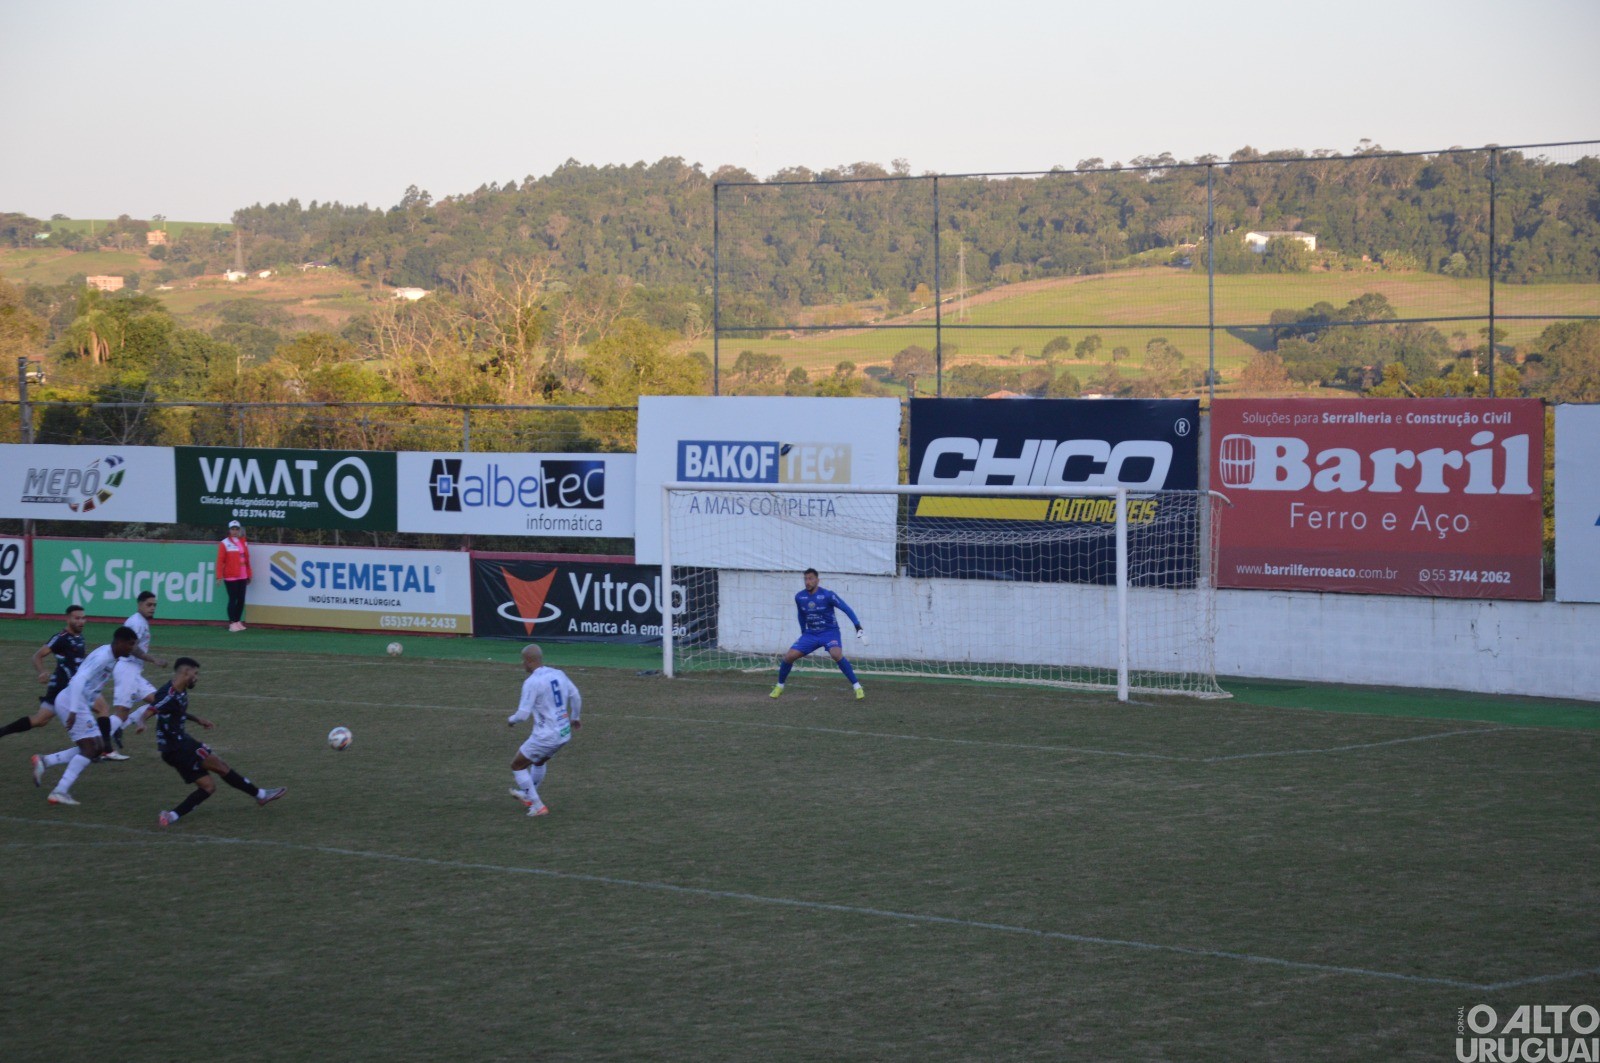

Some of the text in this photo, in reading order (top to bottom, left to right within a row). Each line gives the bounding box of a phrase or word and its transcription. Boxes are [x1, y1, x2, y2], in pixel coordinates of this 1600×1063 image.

[1242, 411, 1512, 427] Soluções para Serralheria e Construção Civil
[23, 459, 100, 496] MEPÓ
[199, 457, 318, 496] VMAT
[685, 445, 775, 479] BAKOF
[918, 437, 1173, 498] CHICO
[1249, 430, 1533, 494] Barril
[200, 496, 318, 509] Clínica de diagnóstico por imagem
[463, 463, 605, 509] albetec
[249, 510, 267, 518] 3744
[268, 510, 286, 518] 1622
[526, 514, 602, 531] informática
[689, 496, 836, 517] A MAIS COMPLETA
[1290, 502, 1470, 539] Ferro e Aço
[103, 559, 215, 603] Sicredi
[301, 560, 435, 593] STEMETAL
[1236, 563, 1511, 583] www.barrilferroeaco.com.br 55 3744 2062
[309, 594, 401, 607] INDÚSTRIA METALÚRGICA
[568, 572, 686, 615] Vitrola
[568, 618, 686, 636] A marca da emoão
[551, 679, 562, 707] 6
